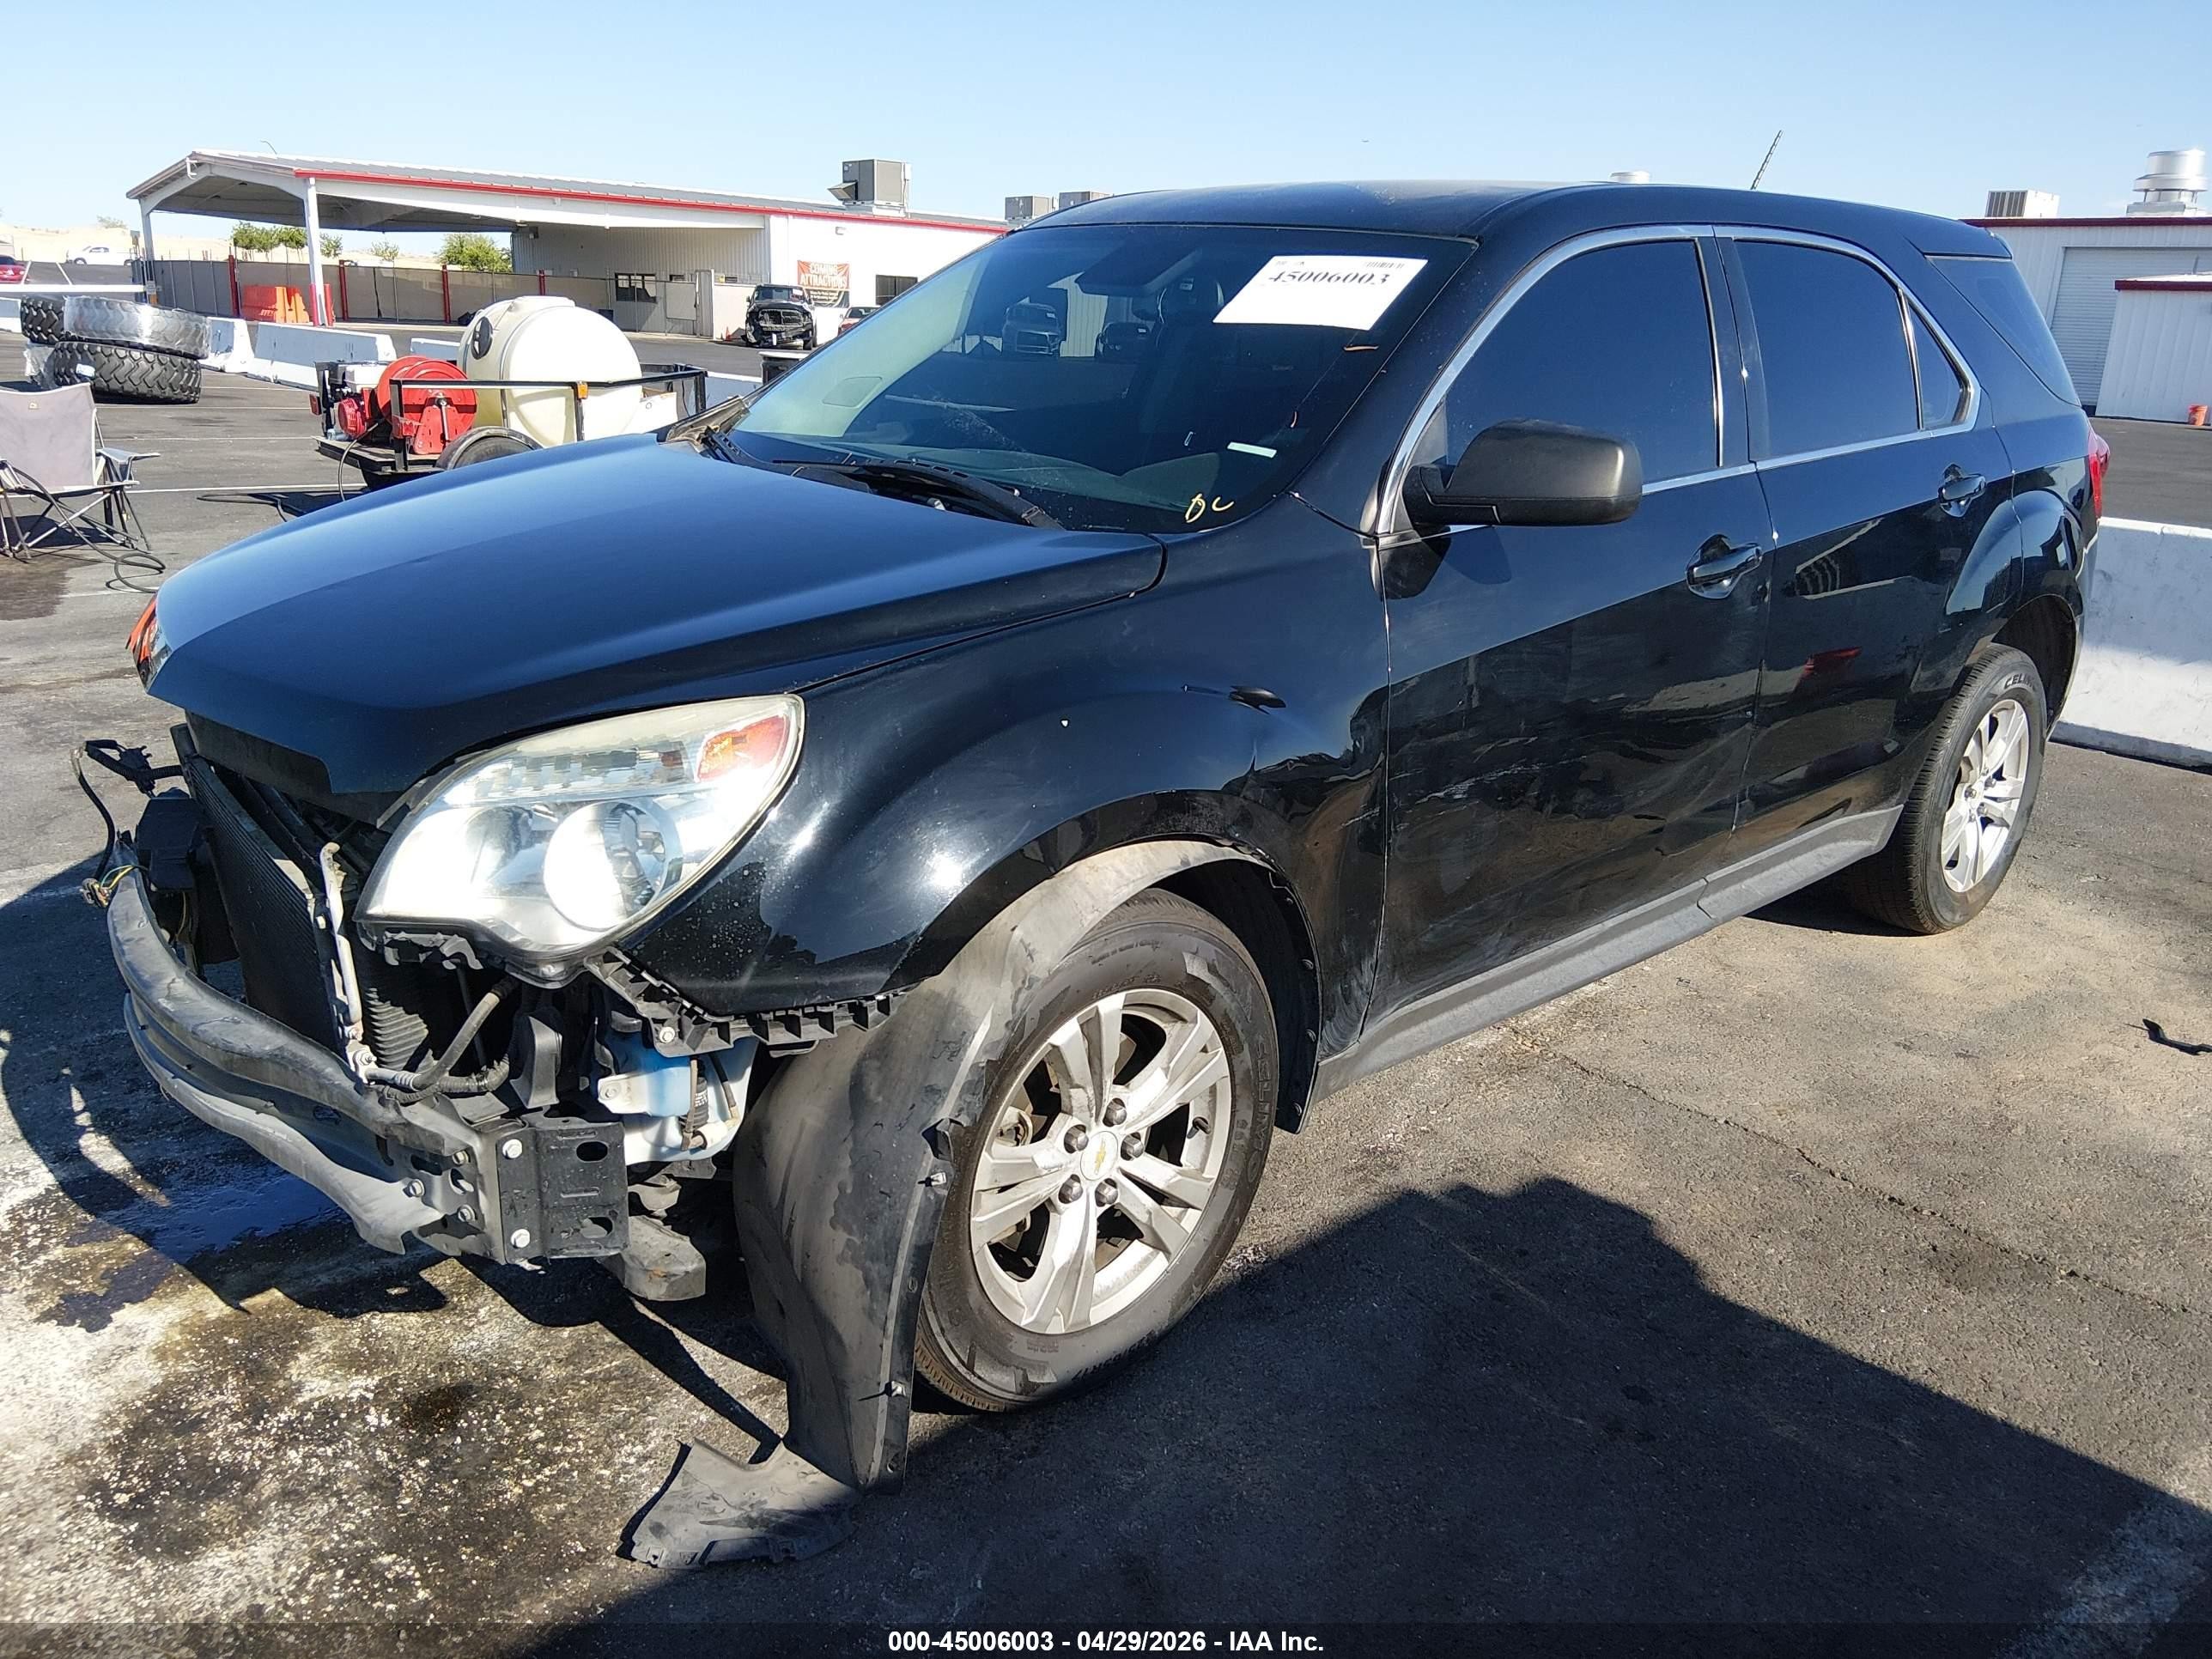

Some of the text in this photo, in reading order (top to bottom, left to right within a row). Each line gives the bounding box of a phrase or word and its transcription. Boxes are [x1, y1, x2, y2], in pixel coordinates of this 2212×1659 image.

[810, 262, 838, 276] COMING
[800, 274, 847, 289] ATTRACTIONS
[1268, 270, 1390, 285] 45006003
